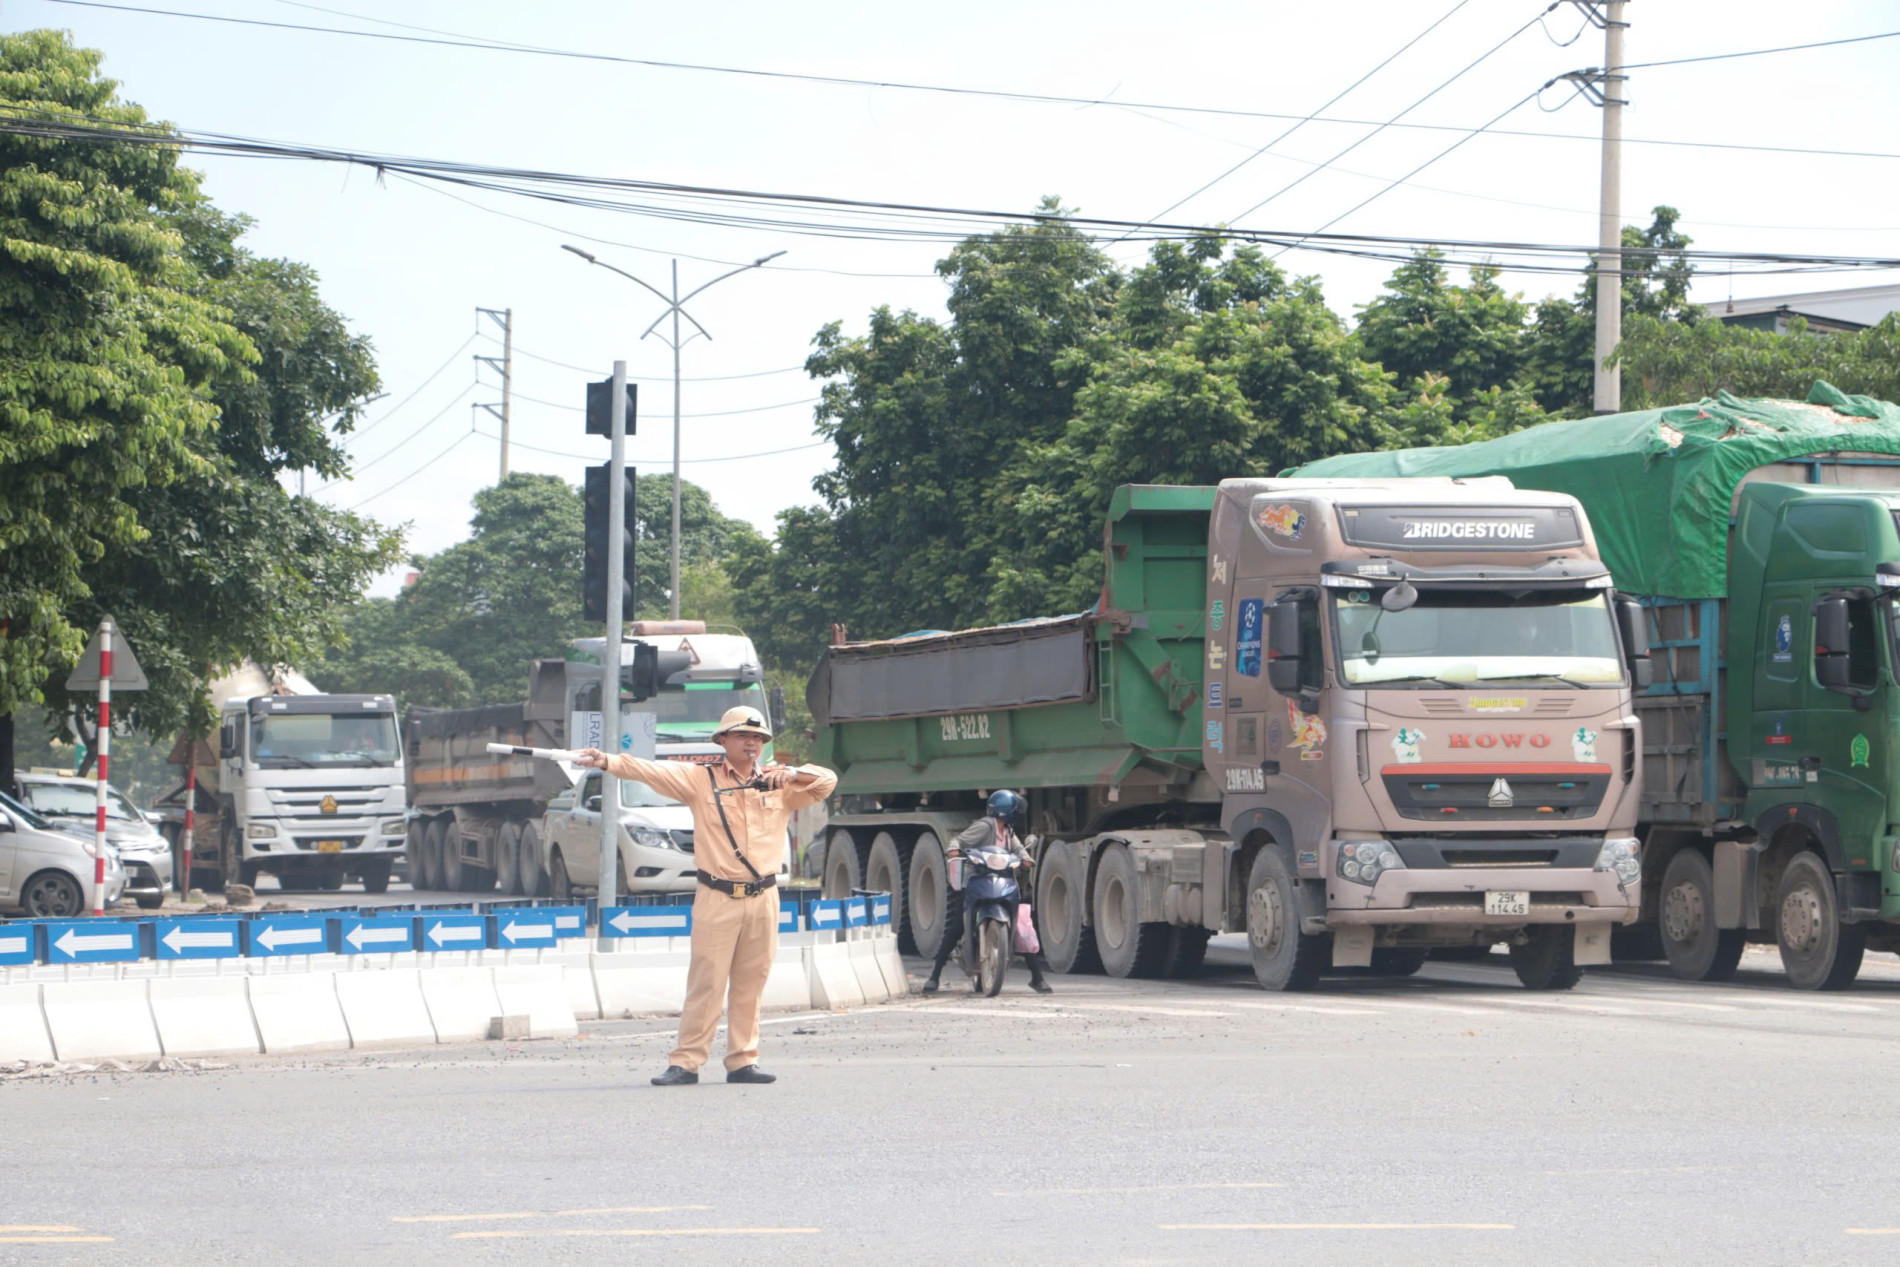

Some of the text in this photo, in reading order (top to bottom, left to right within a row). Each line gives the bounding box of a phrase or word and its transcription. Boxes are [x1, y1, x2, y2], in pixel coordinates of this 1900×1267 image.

[1403, 522, 1536, 539] BRIDGESTONE
[1448, 732, 1552, 749] HOWO
[1498, 892, 1516, 903] 29K
[1491, 904, 1525, 915] 114.45
